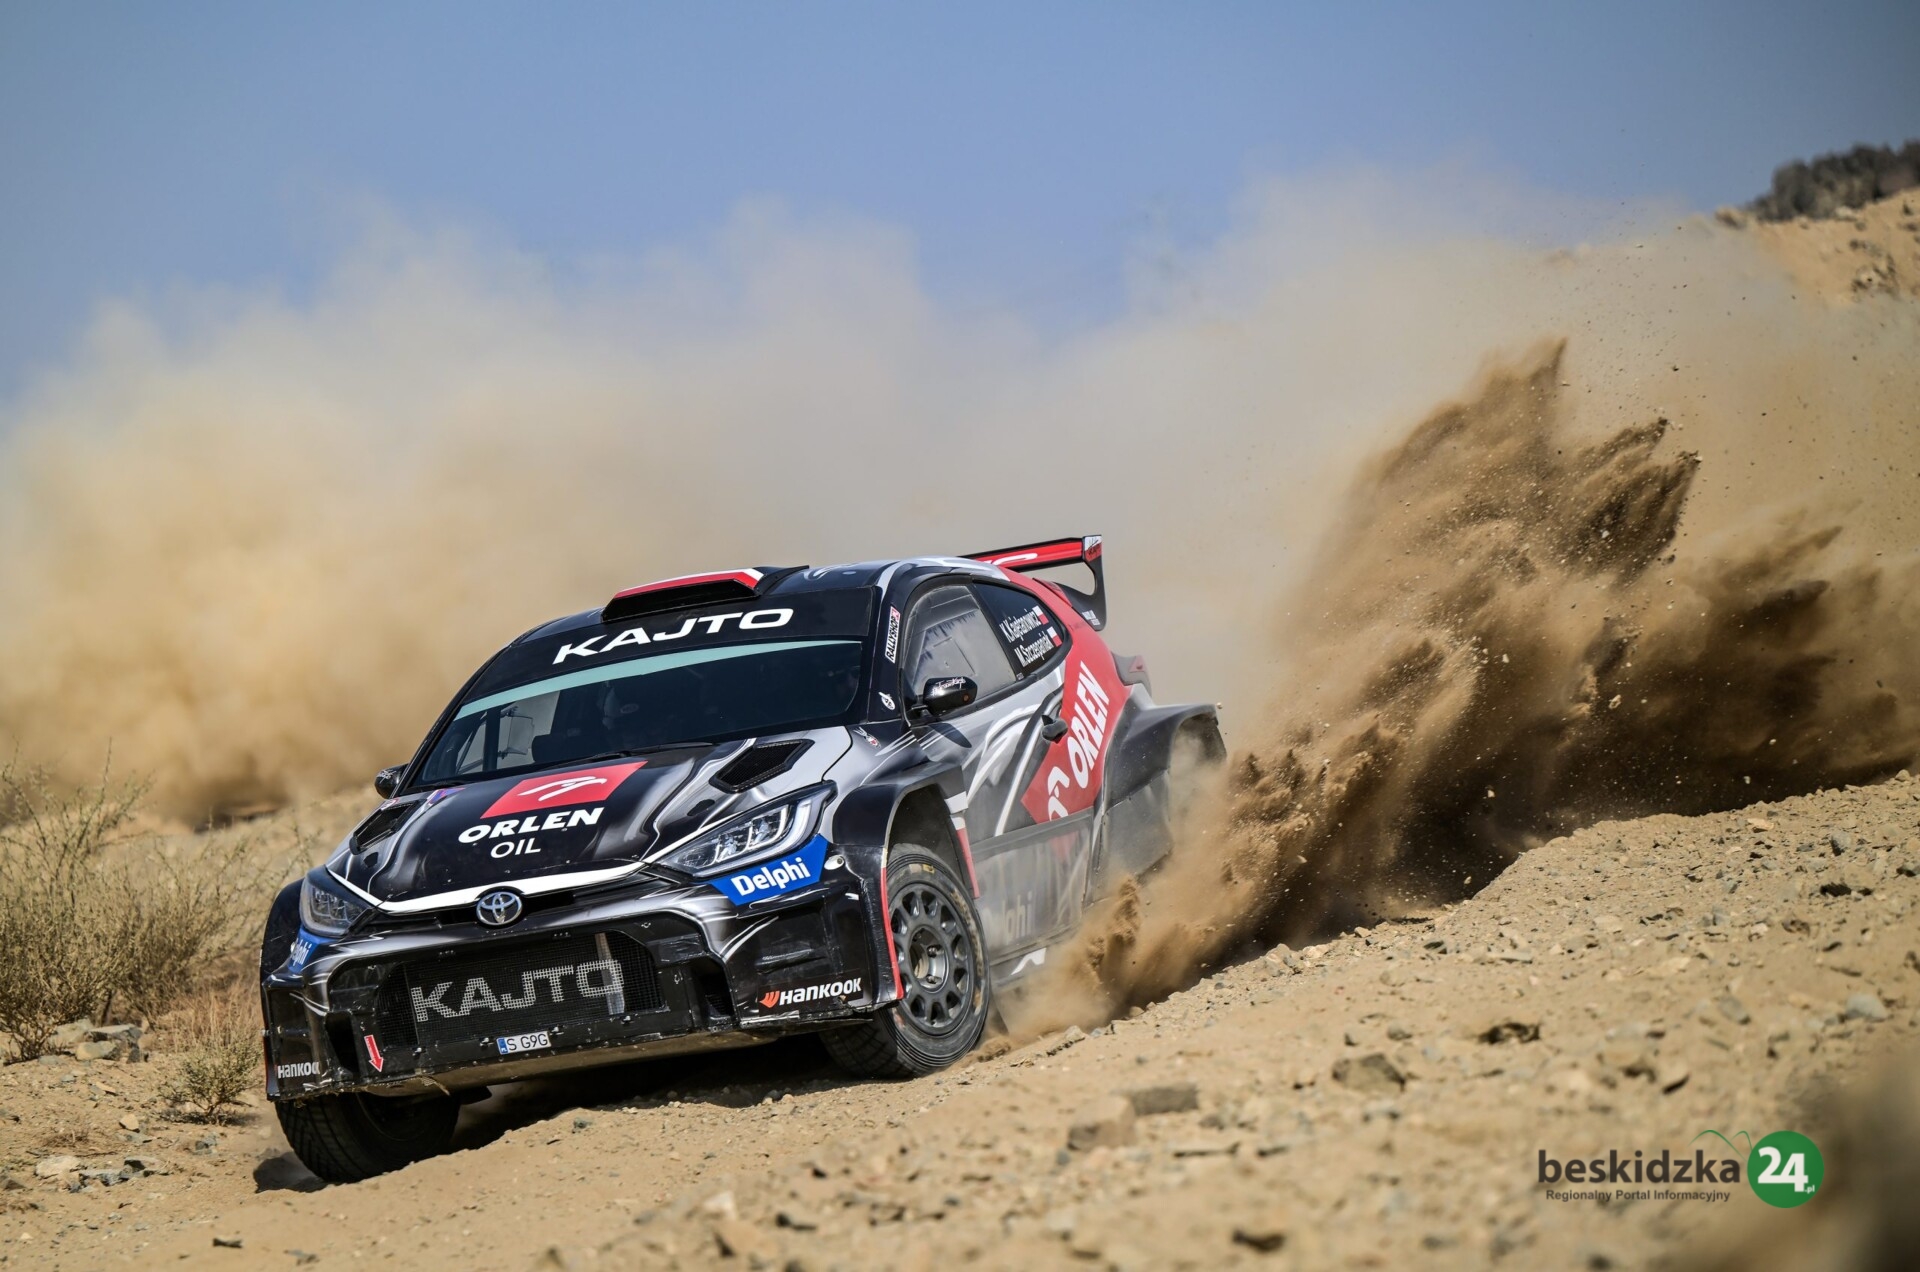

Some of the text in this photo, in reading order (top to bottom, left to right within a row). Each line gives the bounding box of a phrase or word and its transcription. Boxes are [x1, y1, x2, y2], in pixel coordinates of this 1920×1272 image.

[552, 608, 794, 665] KAJTO
[1068, 661, 1109, 789] ORLEN
[458, 807, 604, 844] ORLEN
[490, 838, 541, 859] OIL
[731, 857, 811, 897] Delphi
[411, 959, 625, 1022] KAJTO
[507, 1033, 549, 1051] S G9G
